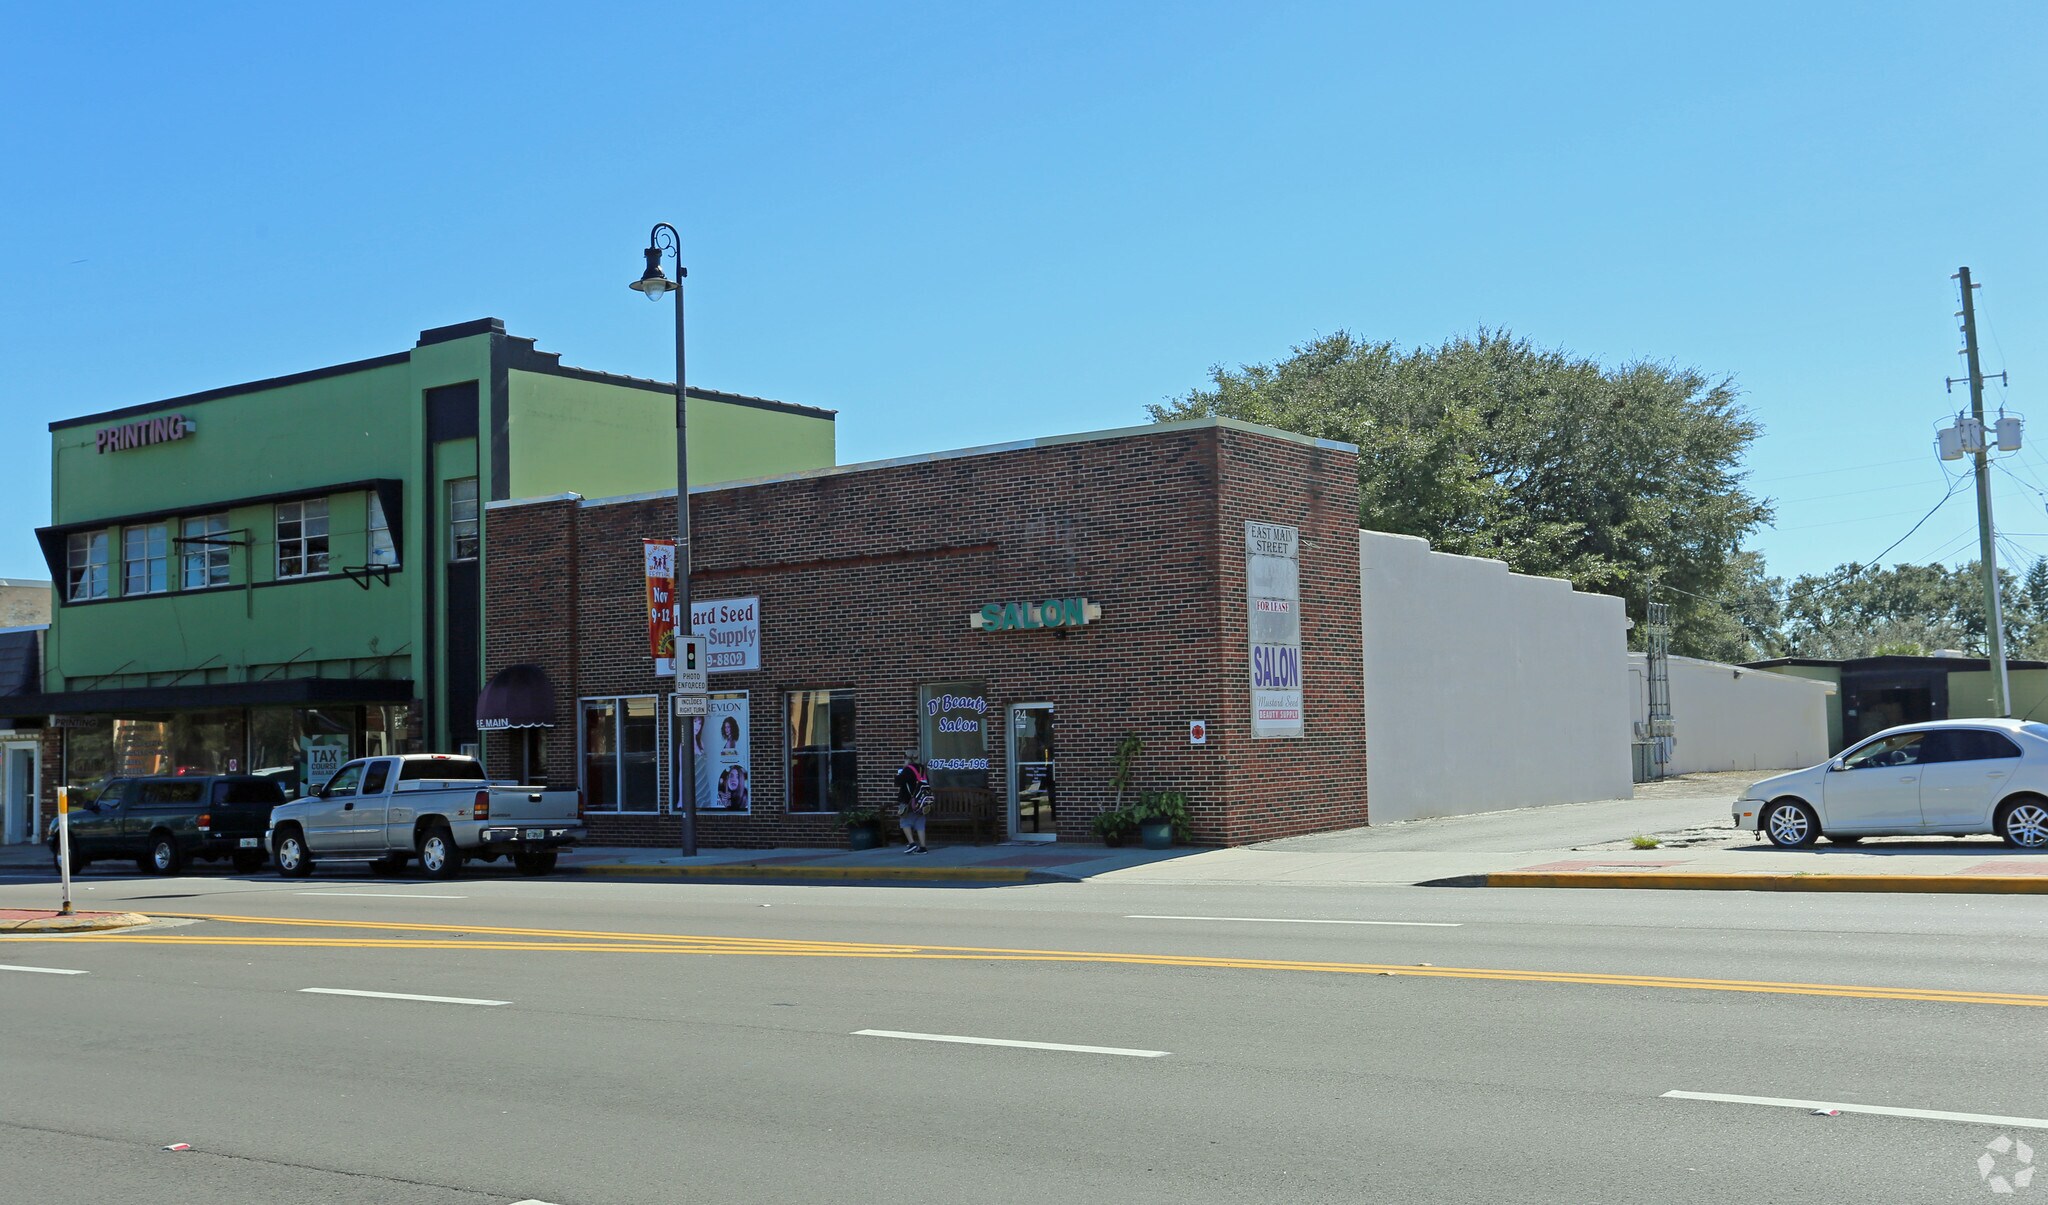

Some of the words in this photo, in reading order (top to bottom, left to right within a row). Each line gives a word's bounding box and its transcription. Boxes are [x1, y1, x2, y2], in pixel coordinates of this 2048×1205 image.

[95, 414, 185, 454] PRINTING
[1251, 526, 1272, 540] EAST
[1273, 528, 1293, 542] MAIN
[1256, 540, 1288, 554] STREET
[720, 603, 753, 623] Seed
[1257, 601, 1270, 611] FOR
[1271, 602, 1289, 613] LEASE
[982, 598, 1086, 631] SALON
[708, 625, 757, 648] Supply
[1254, 646, 1298, 687] SALON
[942, 694, 988, 714] Beauty
[1257, 696, 1283, 708] Mustard
[1285, 695, 1298, 708] Seed
[1015, 709, 1027, 722] 24
[1259, 711, 1278, 719] BEAUTY
[1280, 711, 1298, 719] SUPPLY
[55, 718, 97, 728] PRINTING
[486, 718, 509, 727] MAIN
[939, 717, 978, 732] Salon
[311, 750, 337, 762] TAX
